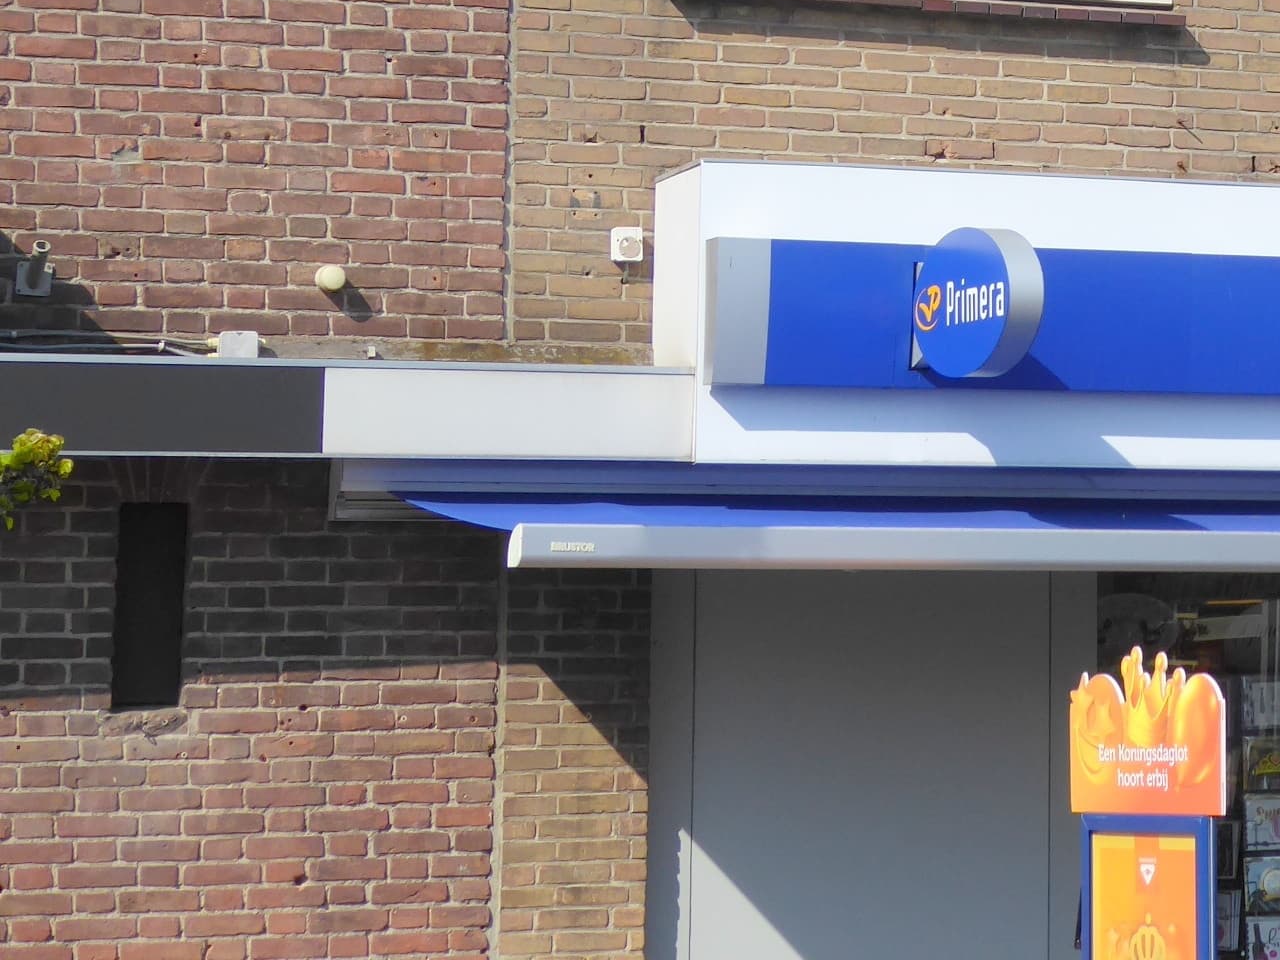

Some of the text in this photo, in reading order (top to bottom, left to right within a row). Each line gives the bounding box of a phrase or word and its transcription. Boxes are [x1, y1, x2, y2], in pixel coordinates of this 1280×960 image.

[946, 278, 1005, 327] Primera
[1098, 744, 1188, 767] Een Koningsdaglot
[1117, 768, 1168, 791] hoort erbij
